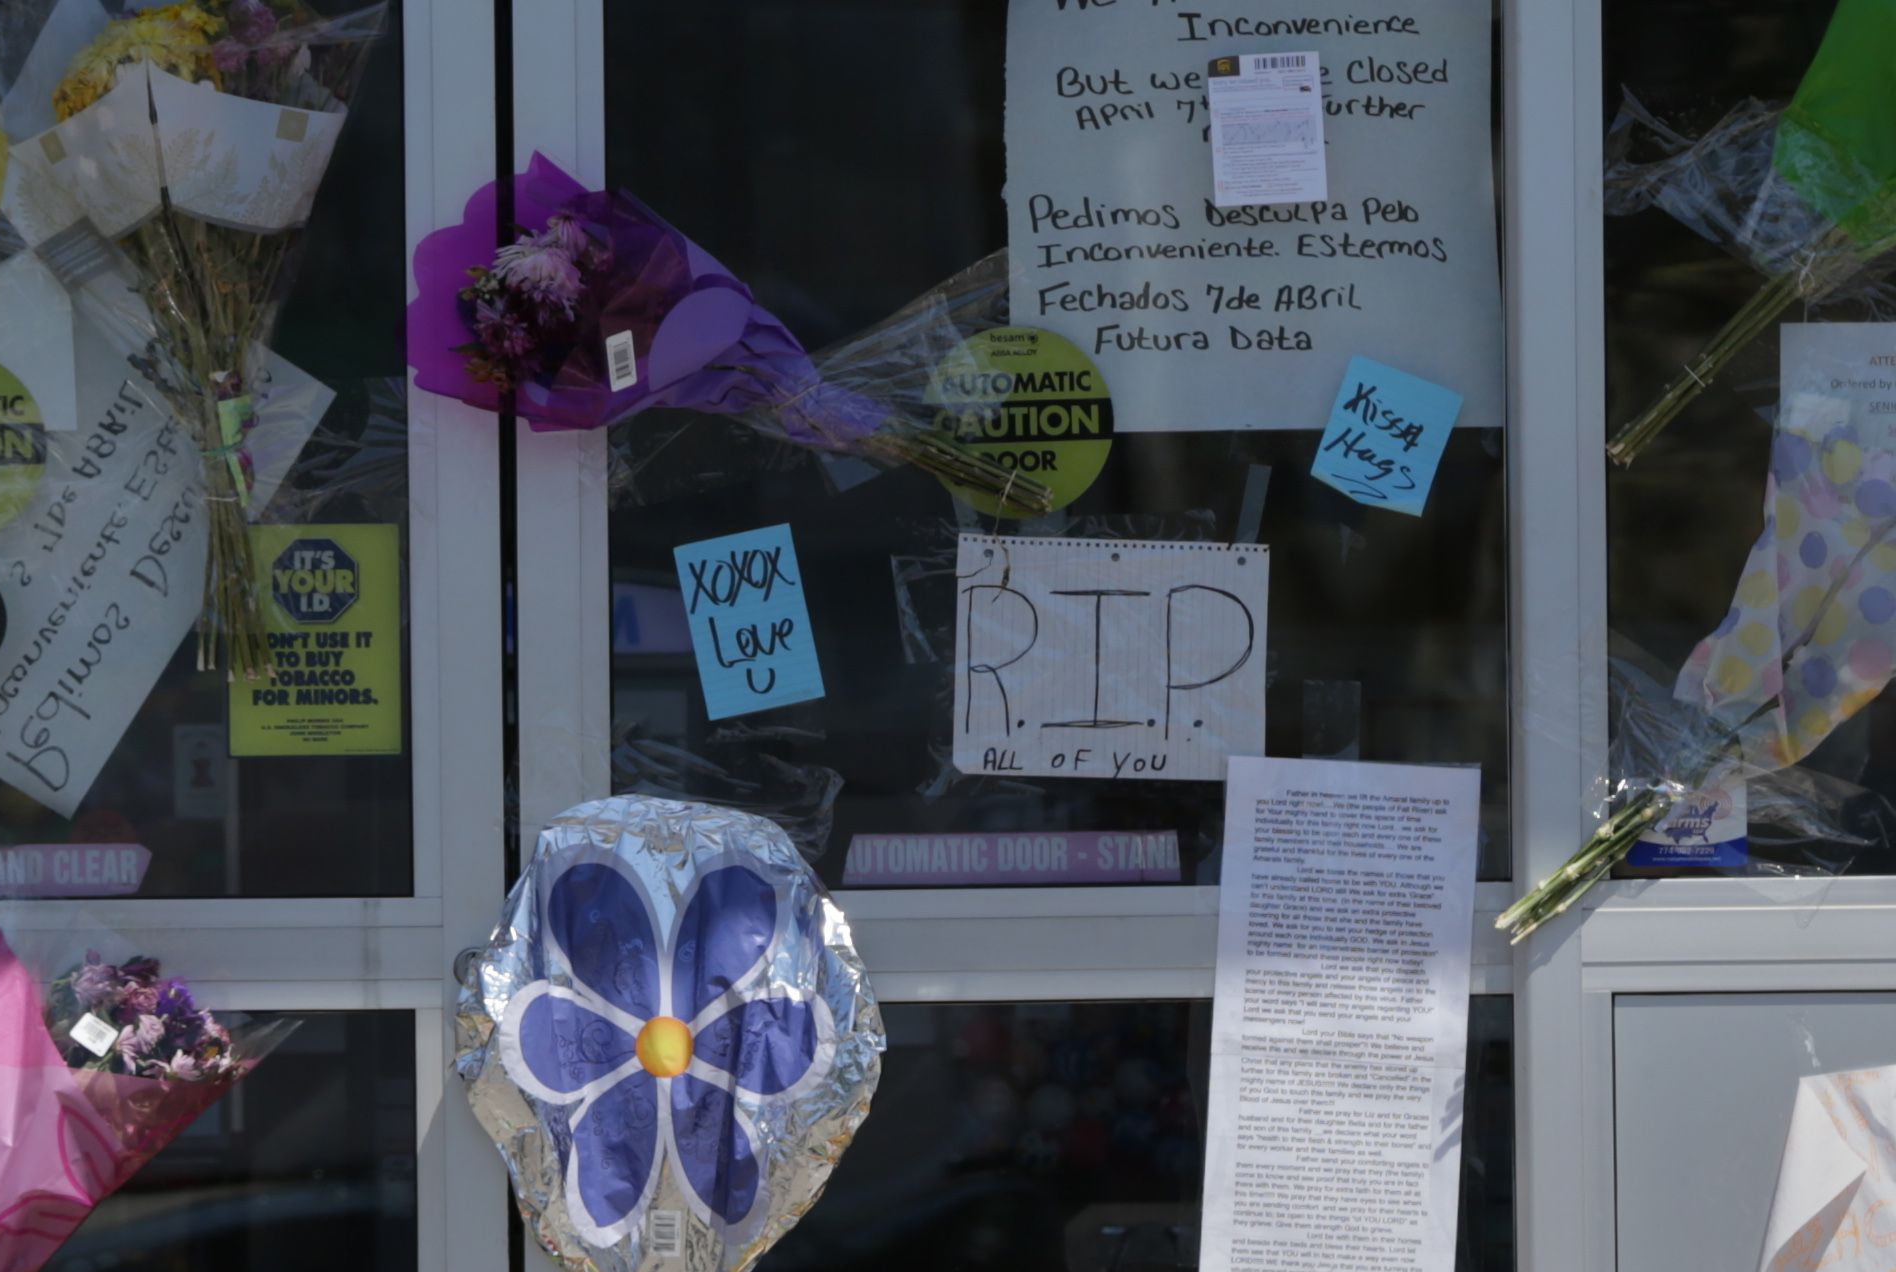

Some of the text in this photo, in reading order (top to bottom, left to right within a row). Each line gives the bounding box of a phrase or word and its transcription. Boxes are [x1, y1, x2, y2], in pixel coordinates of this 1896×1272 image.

[1057, 66, 1135, 98] But
[1027, 194, 1181, 233] Pedimos
[1038, 282, 1190, 316] Fechados
[1094, 323, 1314, 355] Futura Data
[1879, 378, 1892, 391] by
[934, 404, 1099, 438] CAUTION
[293, 550, 335, 570] IT'S
[275, 569, 354, 594] YOUR
[688, 545, 796, 613] XOXOX
[300, 593, 332, 612] I.D.
[268, 632, 373, 649] ON'T USE IT
[275, 651, 344, 668] TO BUY
[253, 688, 379, 706] FOR MINORS.
[982, 745, 1025, 773] ALL
[1050, 747, 1091, 772] OF
[52, 847, 138, 884] CLEAR
[997, 837, 1069, 873] DOOR
